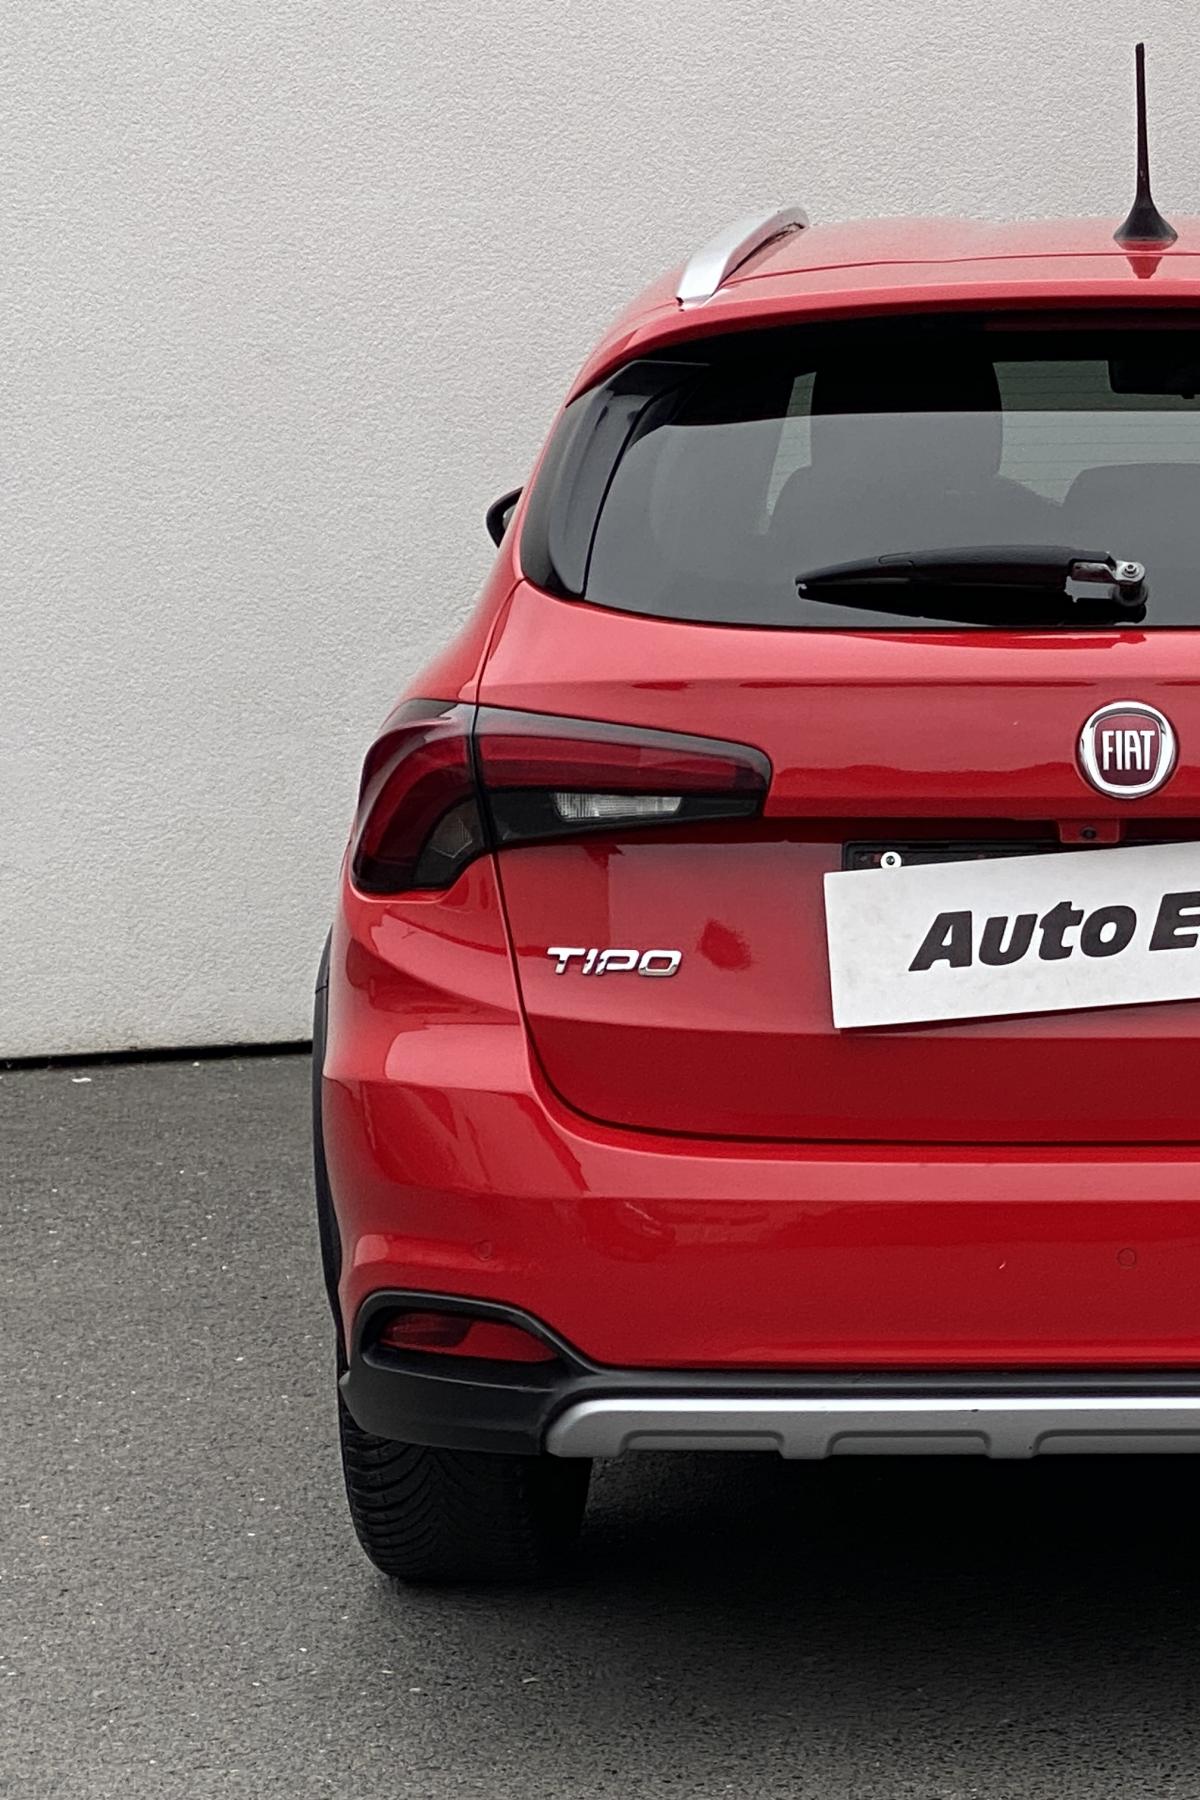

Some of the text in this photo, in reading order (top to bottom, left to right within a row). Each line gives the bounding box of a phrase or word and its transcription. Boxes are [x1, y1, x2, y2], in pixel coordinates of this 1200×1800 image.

[1101, 729, 1156, 771] FIAT
[908, 900, 1138, 972] Auto
[547, 946, 683, 977] TIPO
